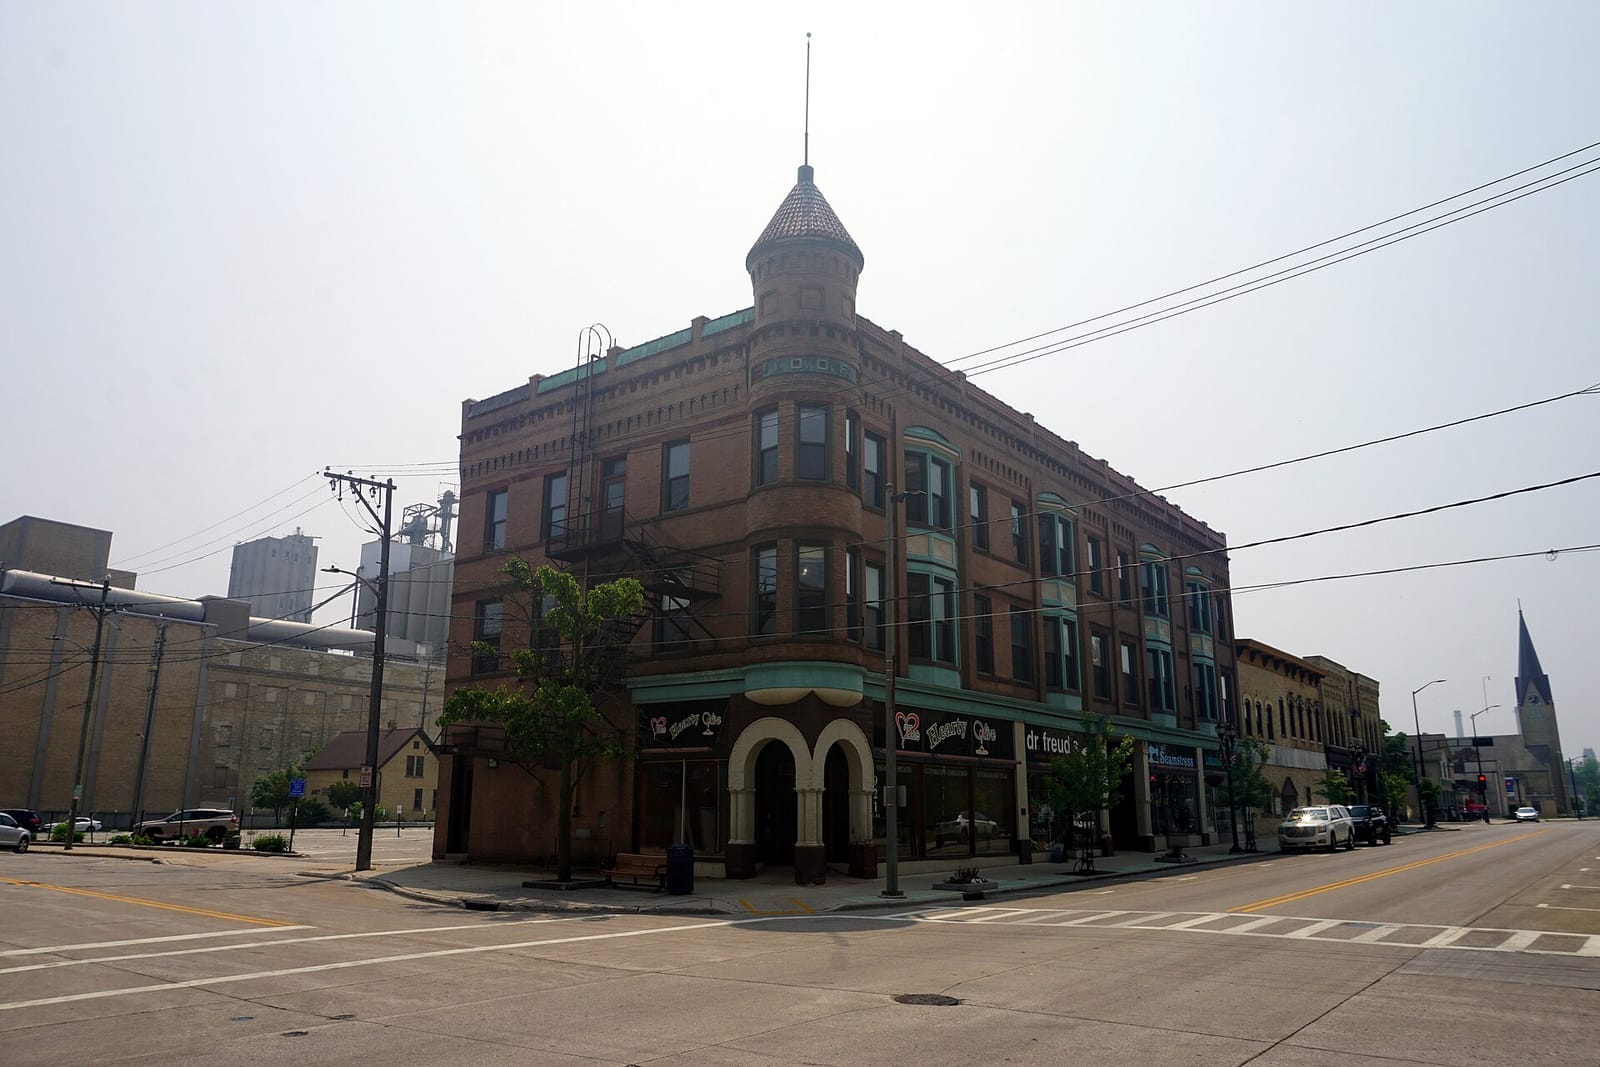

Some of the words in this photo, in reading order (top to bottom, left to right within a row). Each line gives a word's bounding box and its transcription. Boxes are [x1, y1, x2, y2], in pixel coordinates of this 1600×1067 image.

[668, 713, 700, 741] Hearty
[925, 717, 968, 750] Hearty
[1160, 750, 1194, 767] Seamstress
